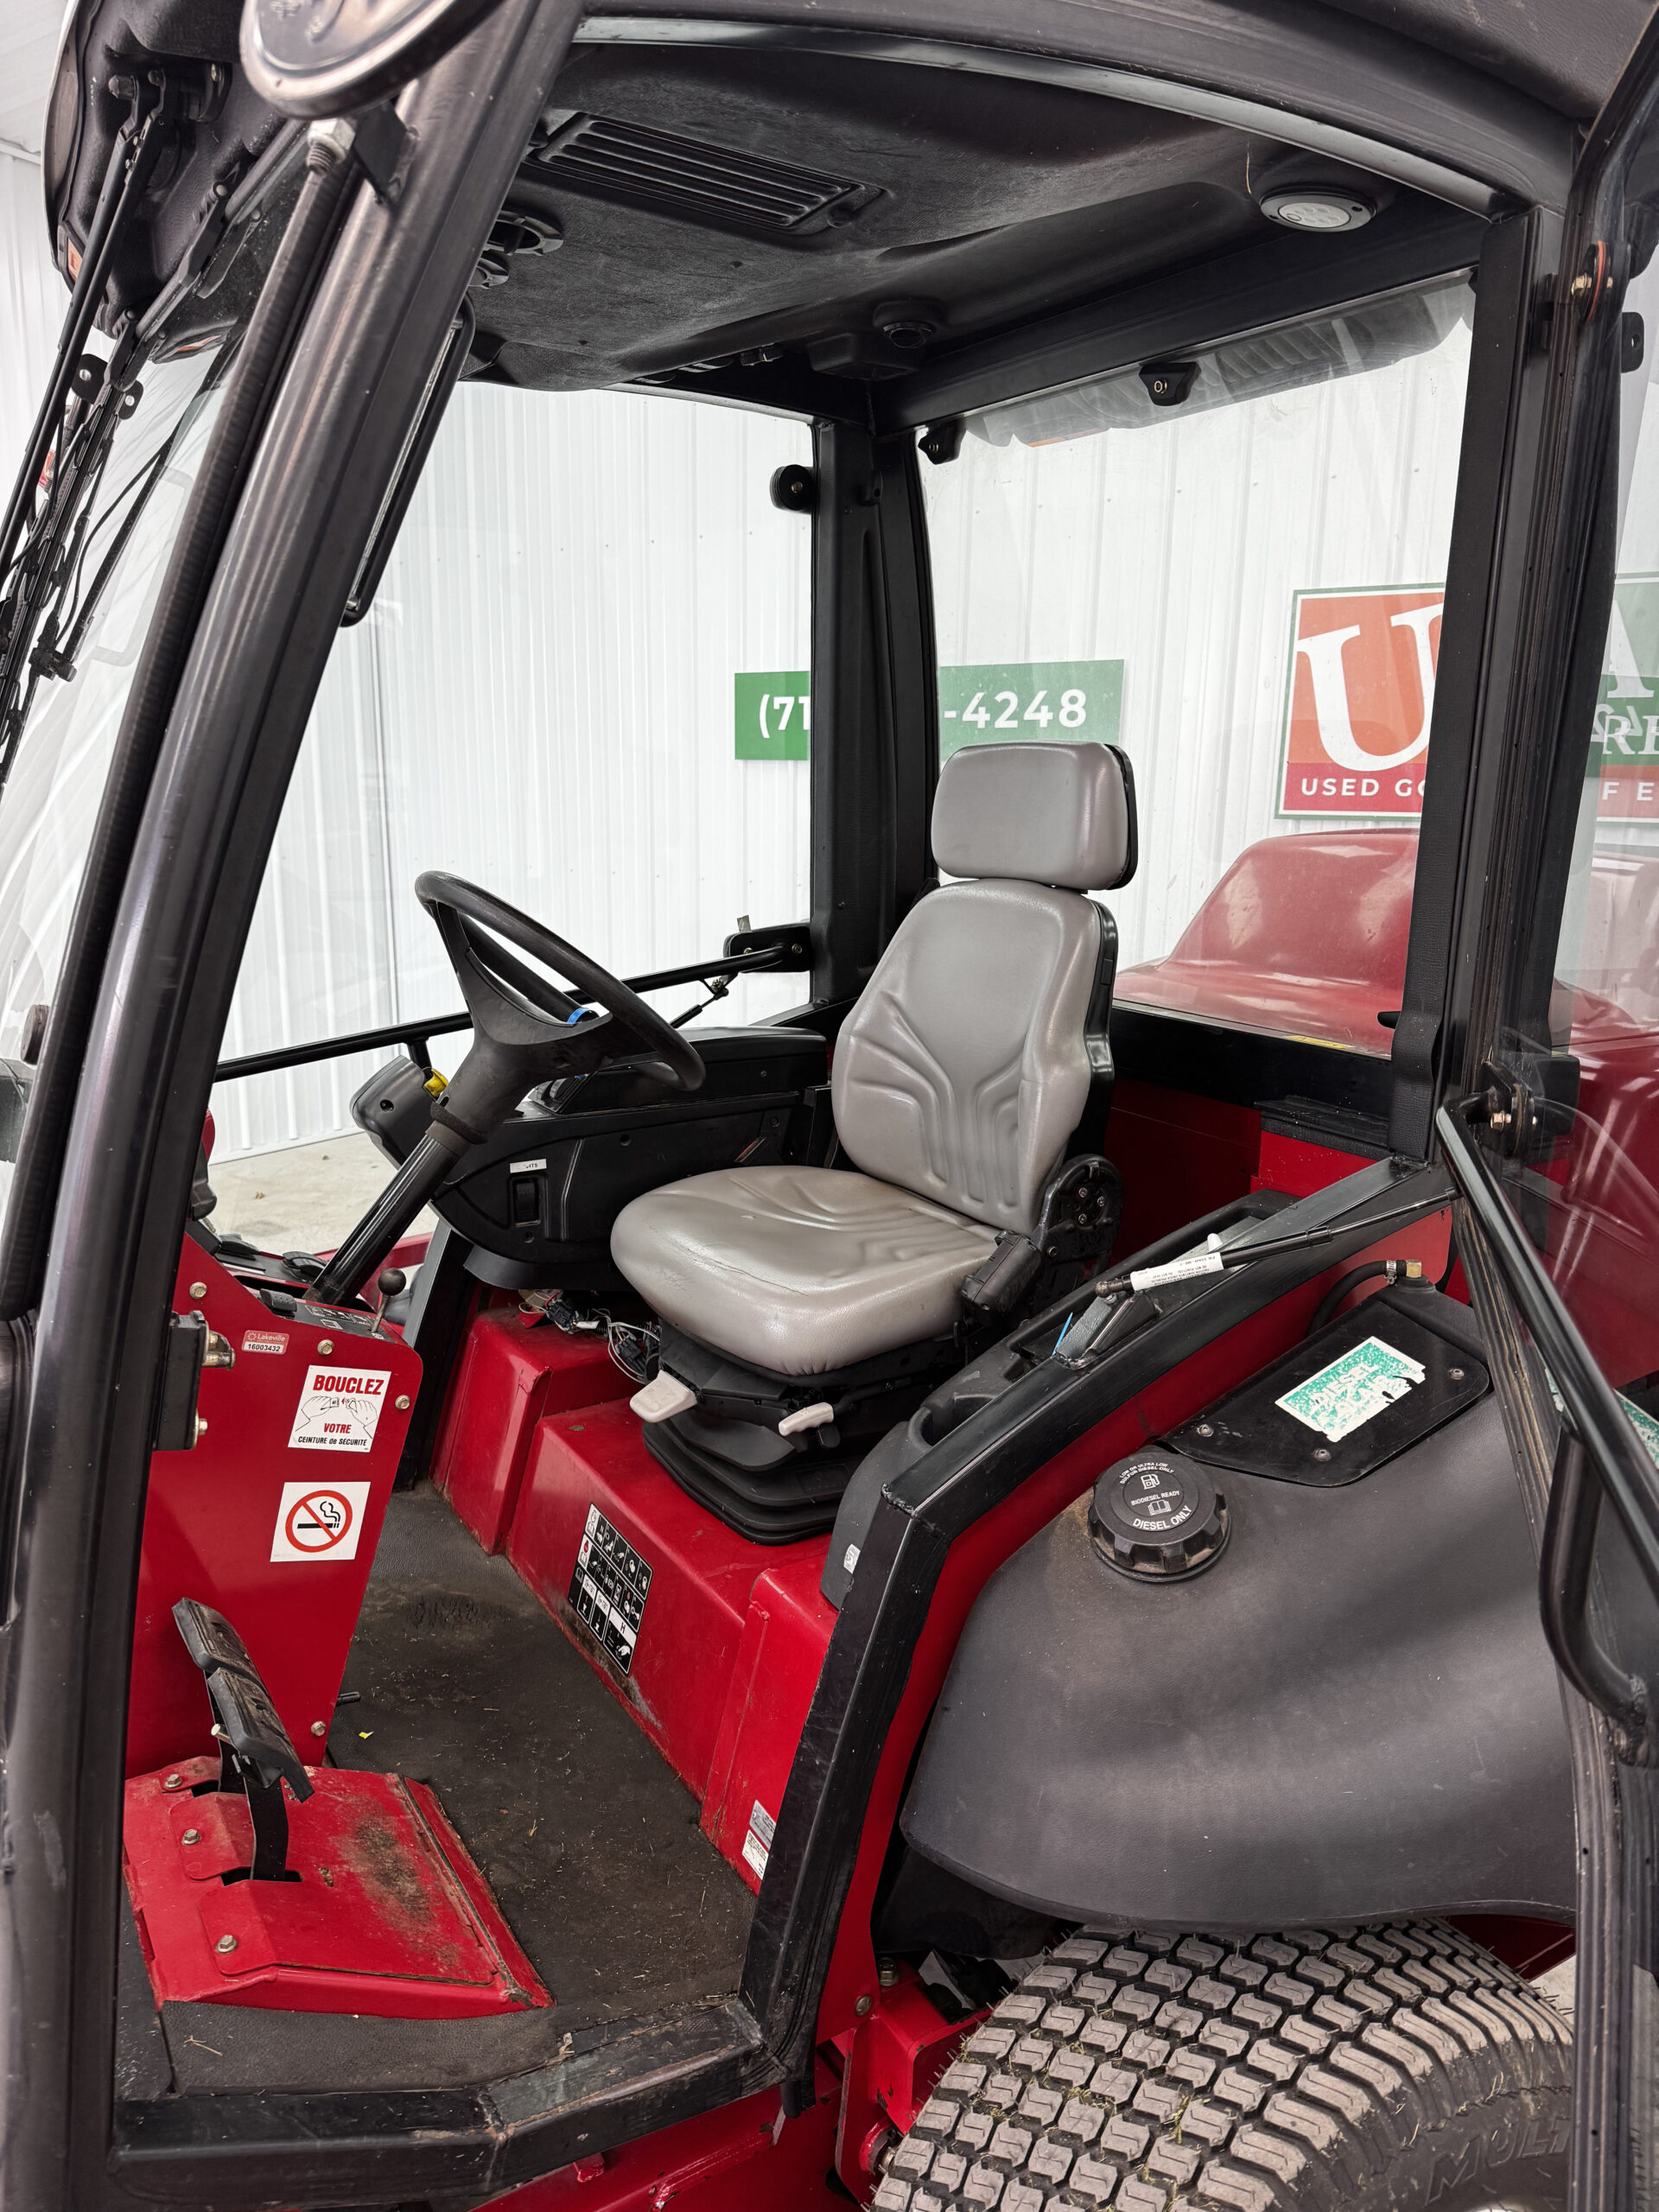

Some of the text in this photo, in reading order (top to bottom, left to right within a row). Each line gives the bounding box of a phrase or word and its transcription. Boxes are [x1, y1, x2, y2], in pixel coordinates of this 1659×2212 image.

[760, 694, 810, 739] (71
[944, 689, 1086, 728] -4248
[1301, 778, 1379, 797] USED
[248, 1344, 281, 1352] 16003432
[313, 1374, 385, 1395] BOUCLEZ
[323, 1422, 352, 1434] VOTRE
[298, 1436, 327, 1445] CEINTURE
[1131, 1494, 1160, 1505] BIODIESEL
[1133, 1504, 1192, 1530] DIESEL ONLY
